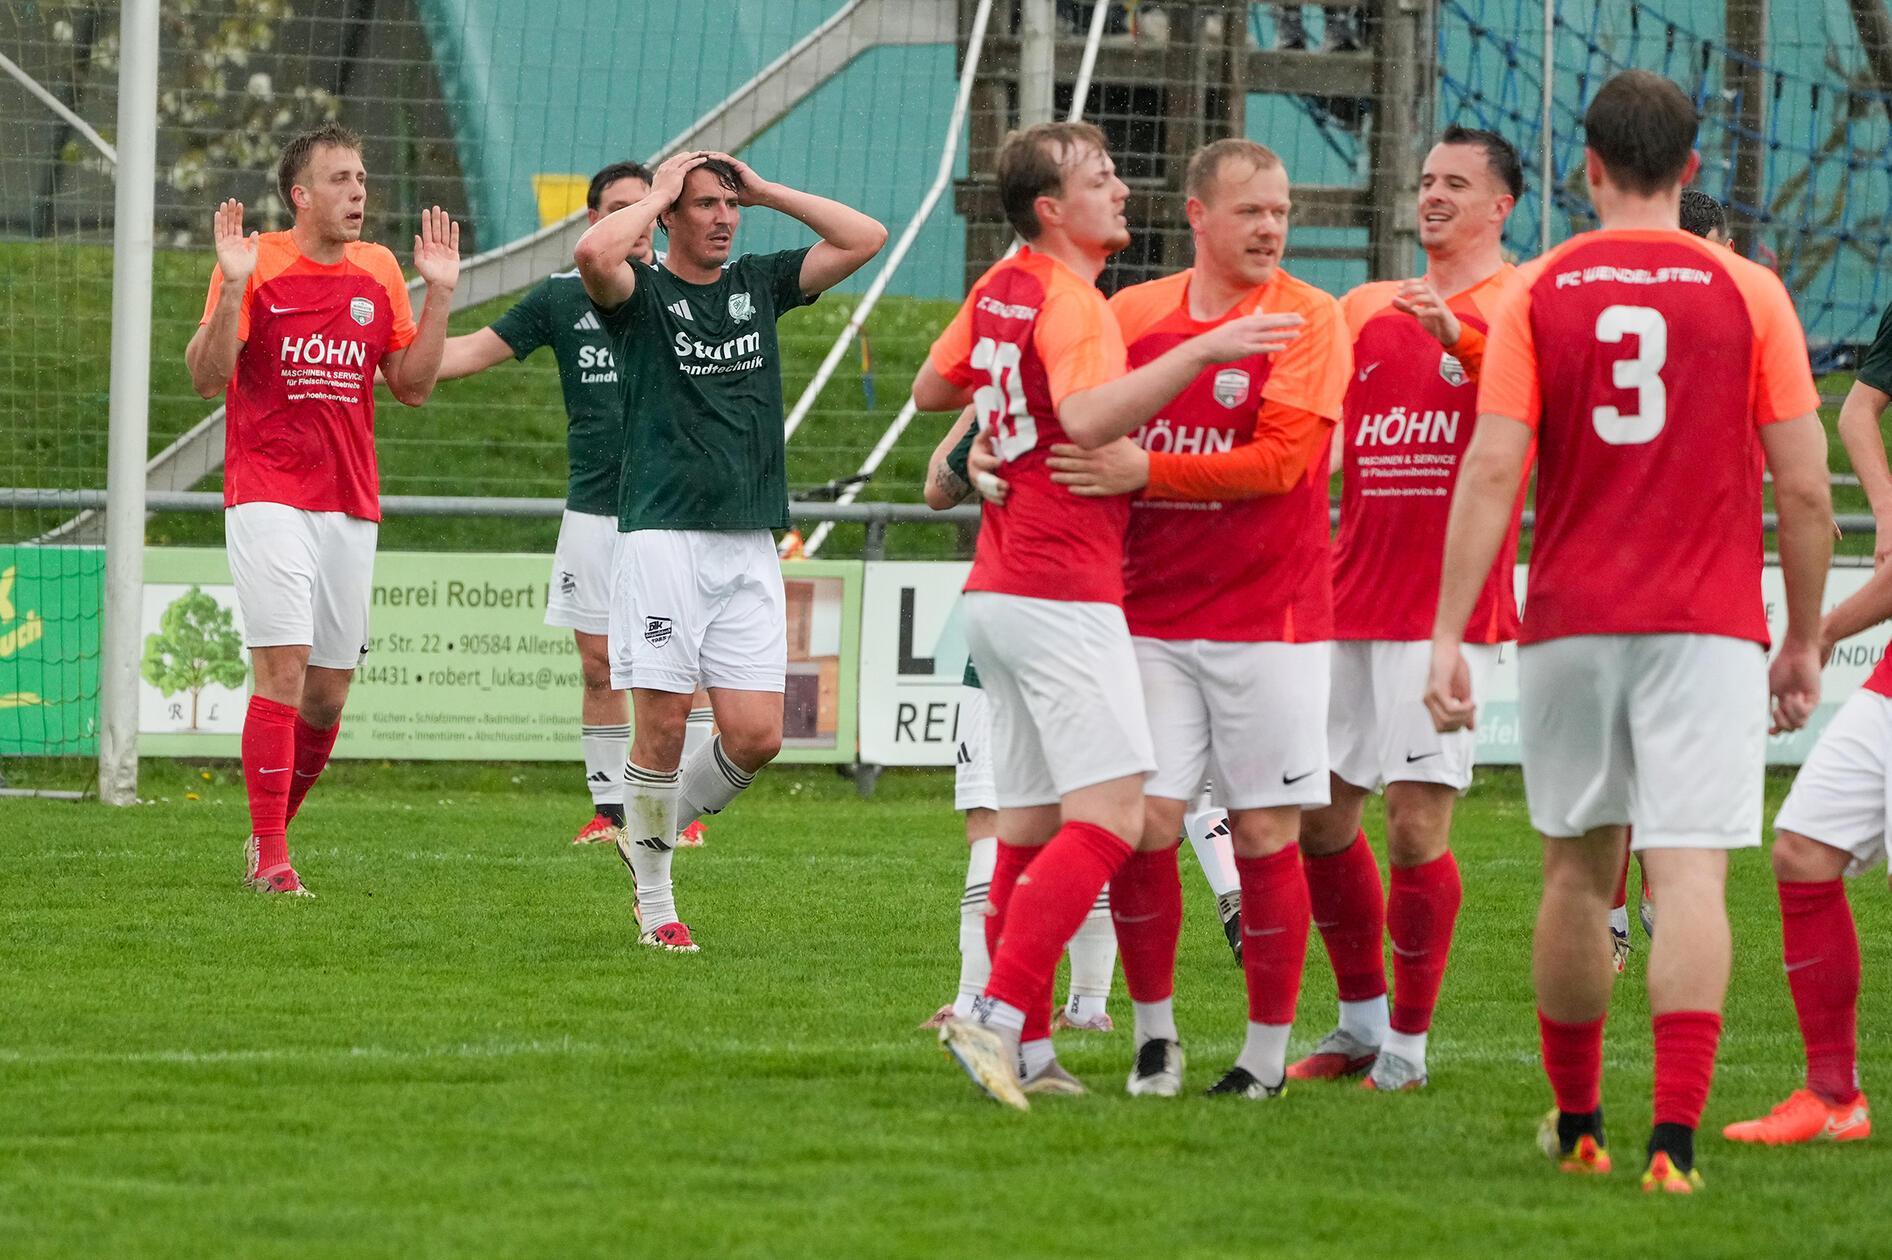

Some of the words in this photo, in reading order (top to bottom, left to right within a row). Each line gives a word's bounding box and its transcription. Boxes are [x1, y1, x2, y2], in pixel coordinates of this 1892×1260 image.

[1556, 270, 1581, 289] FC
[1582, 265, 1712, 285] WENDELSTEIN
[281, 334, 366, 367] HÖHN
[674, 331, 760, 360] Sturm
[281, 369, 325, 377] MASCHINEN
[1592, 305, 1667, 445] 3
[970, 336, 1038, 462] 20
[1355, 407, 1460, 446] HÖHN
[447, 580, 535, 608] Robert
[388, 633, 414, 653] Str.
[420, 634, 440, 653] 22
[460, 634, 512, 655] 90584
[516, 635, 578, 656] Allersb
[898, 588, 935, 675] L
[353, 666, 409, 685] 14431
[168, 703, 183, 720] R
